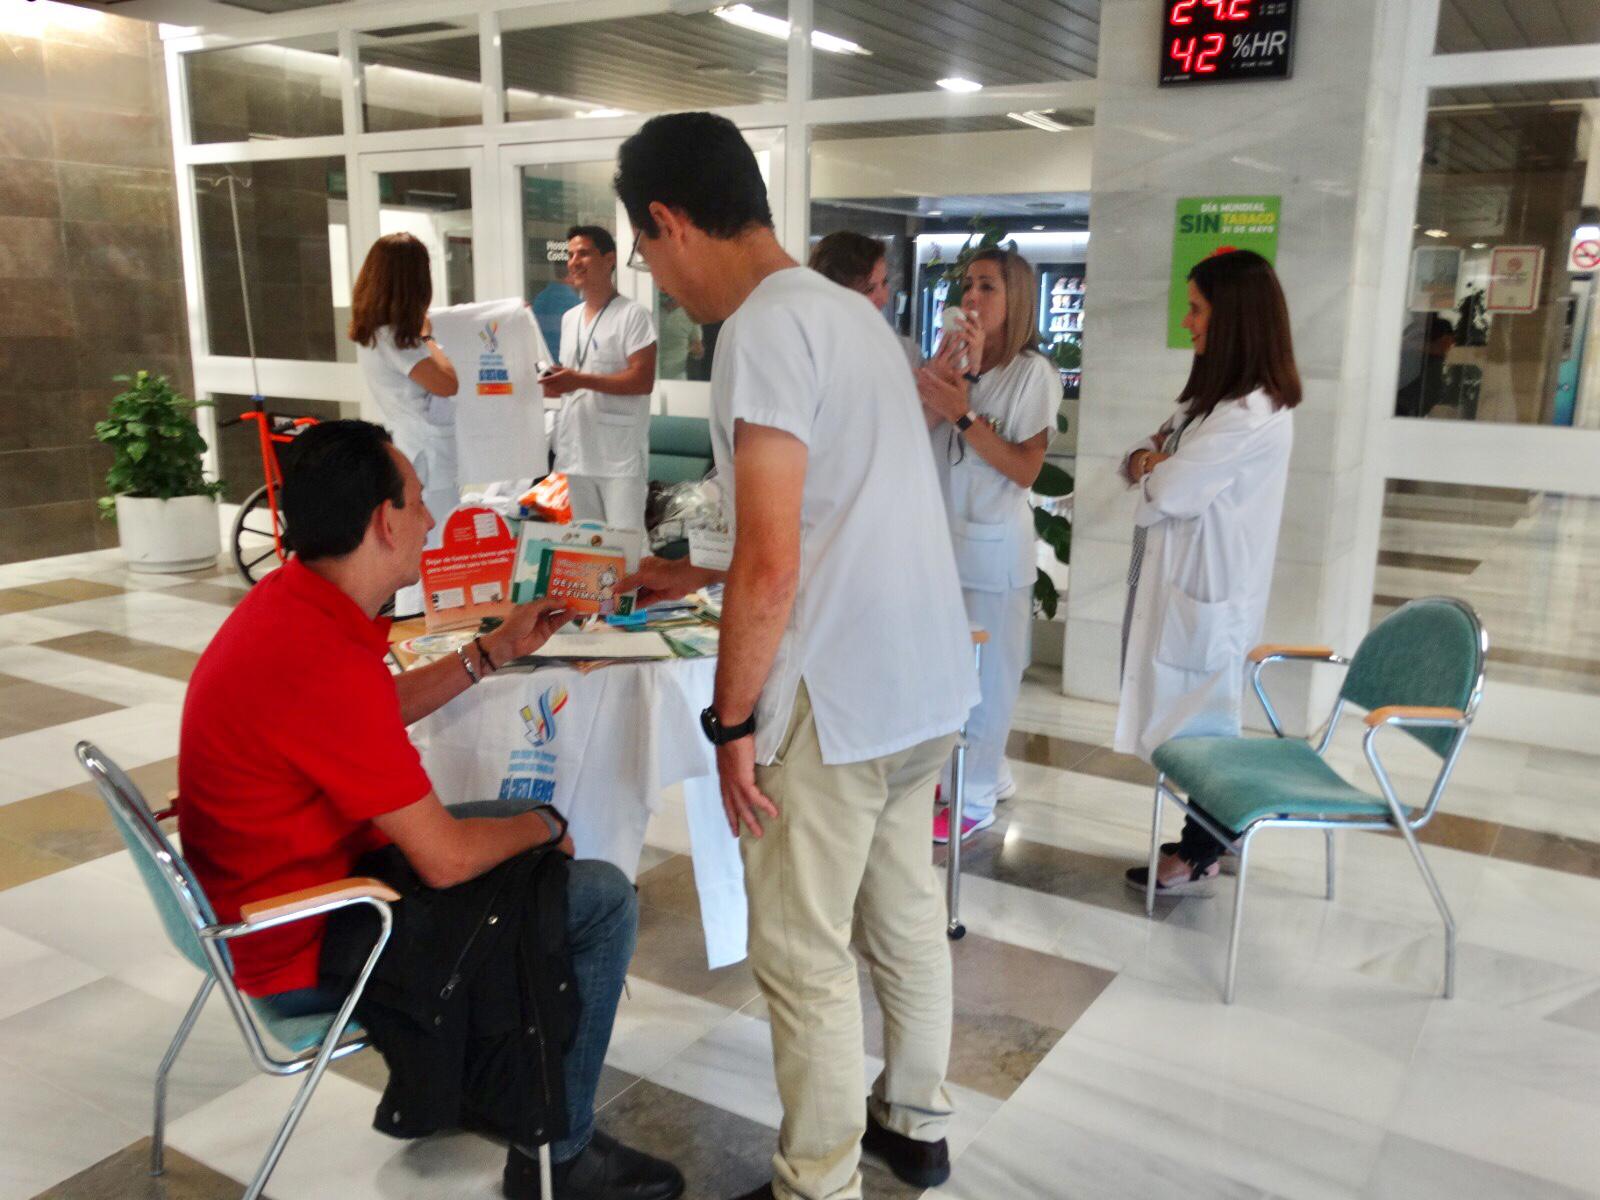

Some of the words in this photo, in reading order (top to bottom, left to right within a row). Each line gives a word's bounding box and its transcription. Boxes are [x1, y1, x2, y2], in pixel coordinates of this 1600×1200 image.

[1170, 33, 1226, 72] 42
[1232, 30, 1287, 59] %HR
[1220, 202, 1265, 212] MUNDIAL
[1180, 213, 1220, 234] SIN
[1222, 213, 1275, 224] TABACO
[1233, 225, 1246, 234] DE
[1248, 224, 1274, 234] MAYO
[551, 588, 563, 597] de
